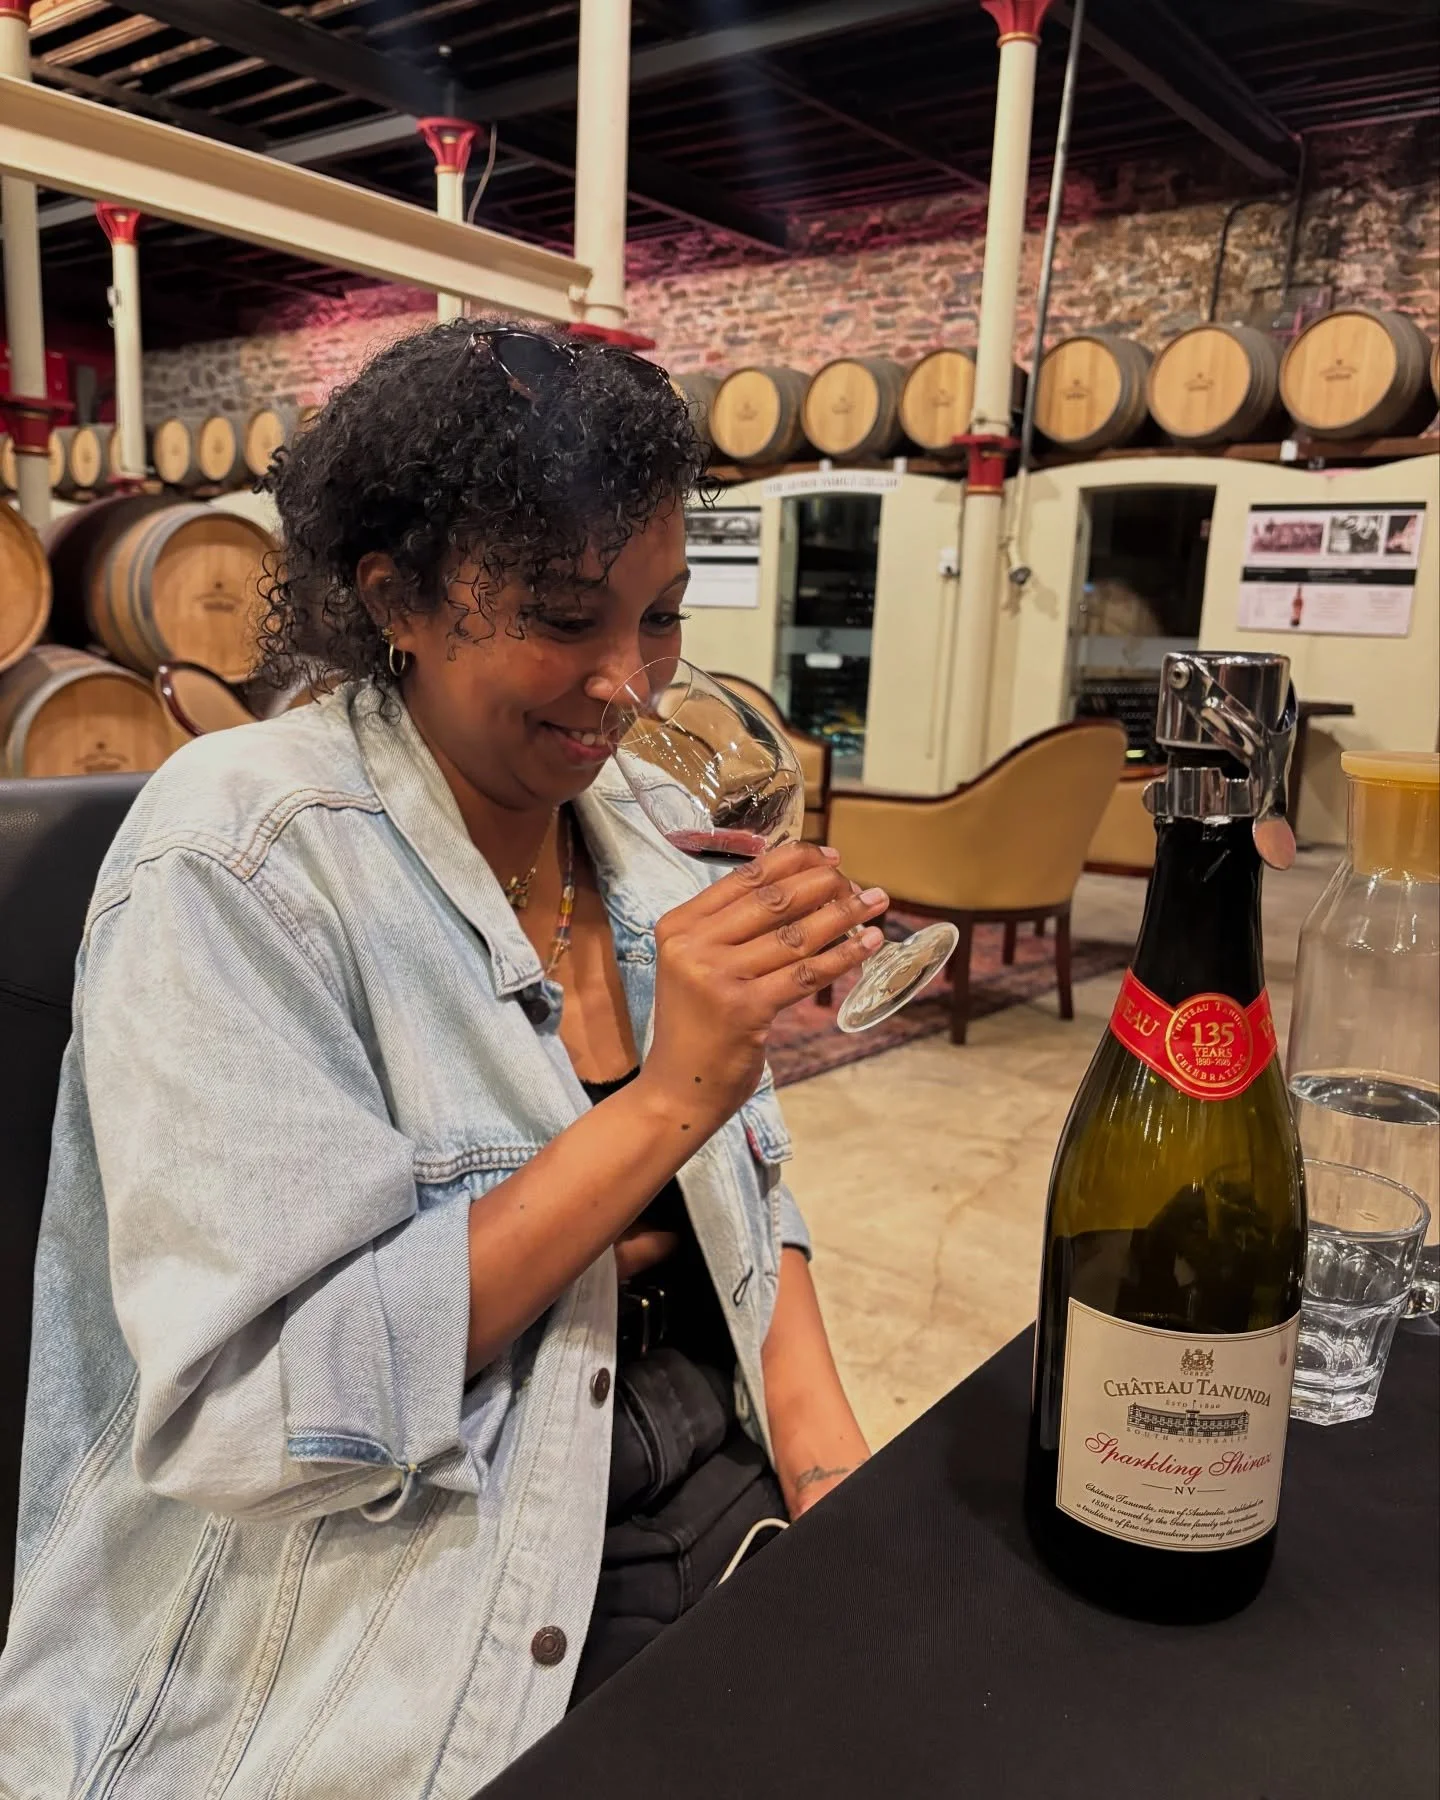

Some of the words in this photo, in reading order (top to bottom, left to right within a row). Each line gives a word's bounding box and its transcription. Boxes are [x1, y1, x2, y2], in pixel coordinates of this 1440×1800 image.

[1190, 1022, 1235, 1048] 135
[1193, 1047, 1233, 1058] YEARS
[1176, 1053, 1246, 1081] CELEBRATING
[1103, 1377, 1193, 1397] CHÂTEAU
[1196, 1378, 1271, 1407] TANUNDA
[1126, 1426, 1169, 1441] SOUTH
[1178, 1435, 1248, 1444] AUSTRALIA
[1085, 1432, 1203, 1485] Sparkling
[1209, 1450, 1272, 1476] Shiraz
[1082, 1504, 1114, 1523] tradition
[1114, 1518, 1126, 1528] of
[1122, 1519, 1139, 1531] fine
[1091, 1498, 1110, 1510] 1890
[1143, 1513, 1154, 1524] by
[1155, 1516, 1168, 1525] the
[1190, 1519, 1218, 1530] family
